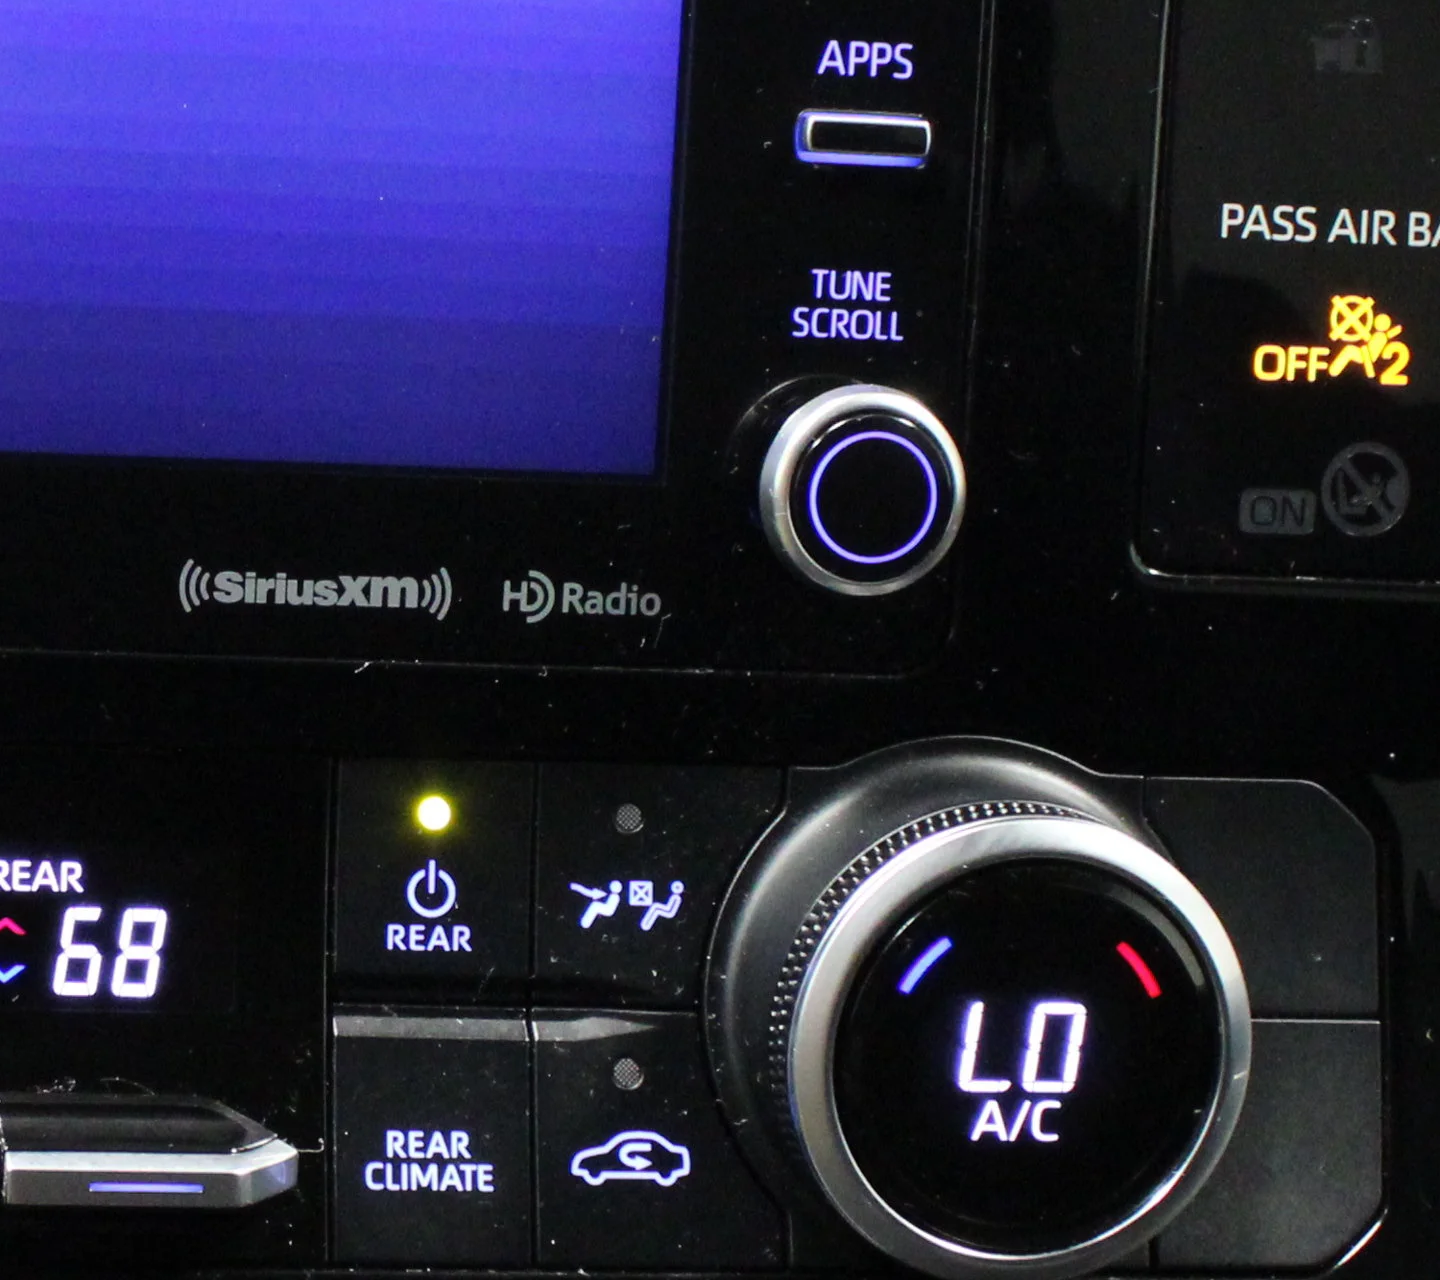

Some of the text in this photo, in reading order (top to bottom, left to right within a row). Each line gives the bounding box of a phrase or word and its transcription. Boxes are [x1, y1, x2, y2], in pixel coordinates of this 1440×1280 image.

[817, 40, 913, 80] APPS
[1221, 203, 1317, 243] PASS
[1328, 209, 1396, 246] AIR
[811, 269, 891, 302] TUNE
[792, 307, 903, 342] SCROLL
[1252, 343, 1328, 382] OFF
[1250, 495, 1307, 527] ON
[562, 582, 661, 616] Radio
[50, 905, 169, 999] 68
[385, 924, 473, 953] REAR
[955, 999, 1088, 1094] LO
[969, 1101, 1061, 1143] A/C
[385, 1130, 472, 1159] REAR
[364, 1160, 495, 1193] CLIMATE
